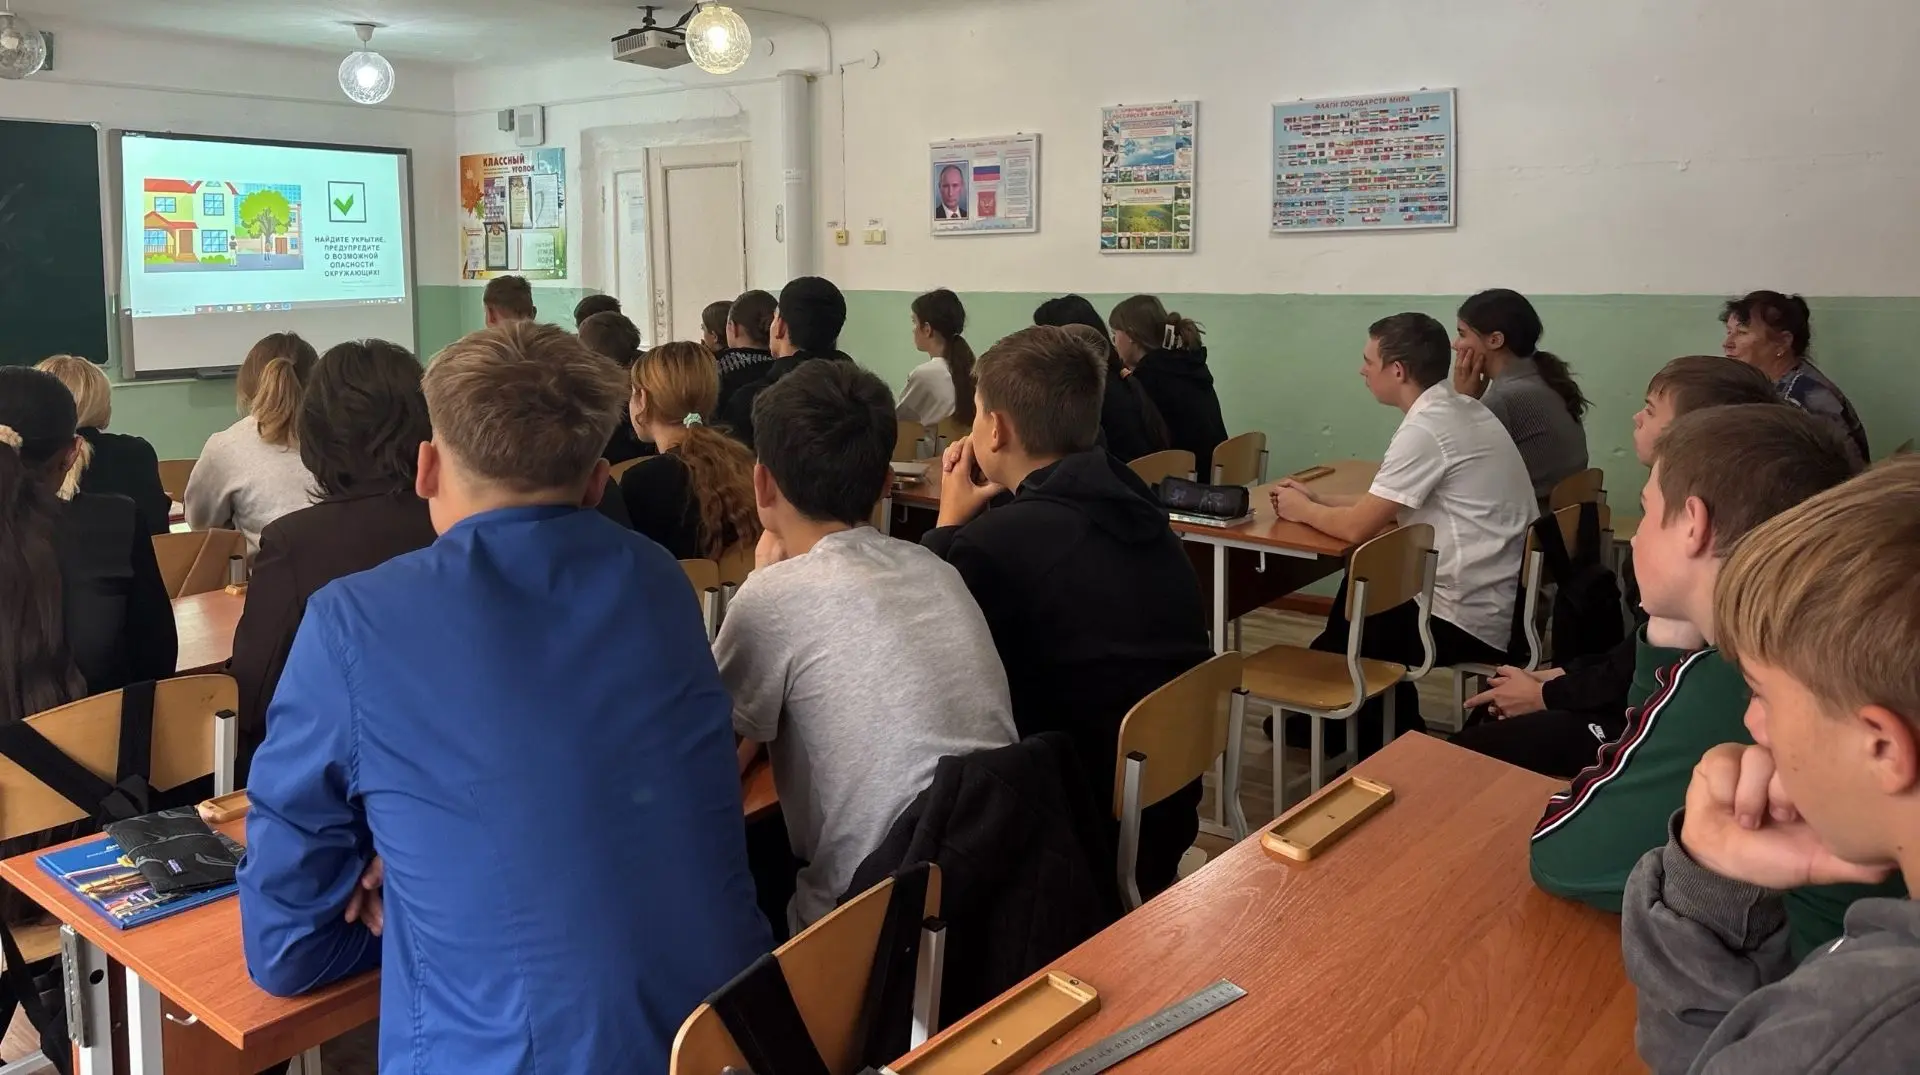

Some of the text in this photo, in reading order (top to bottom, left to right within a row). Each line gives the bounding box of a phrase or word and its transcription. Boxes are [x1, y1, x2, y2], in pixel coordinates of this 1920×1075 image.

[1340, 97, 1387, 107] ГОСУДАРСТВ
[483, 153, 525, 167] КЛАССНЫЙ
[511, 165, 535, 173] УГОЛОК
[332, 252, 379, 260] ВОЗМОЖНОЙ
